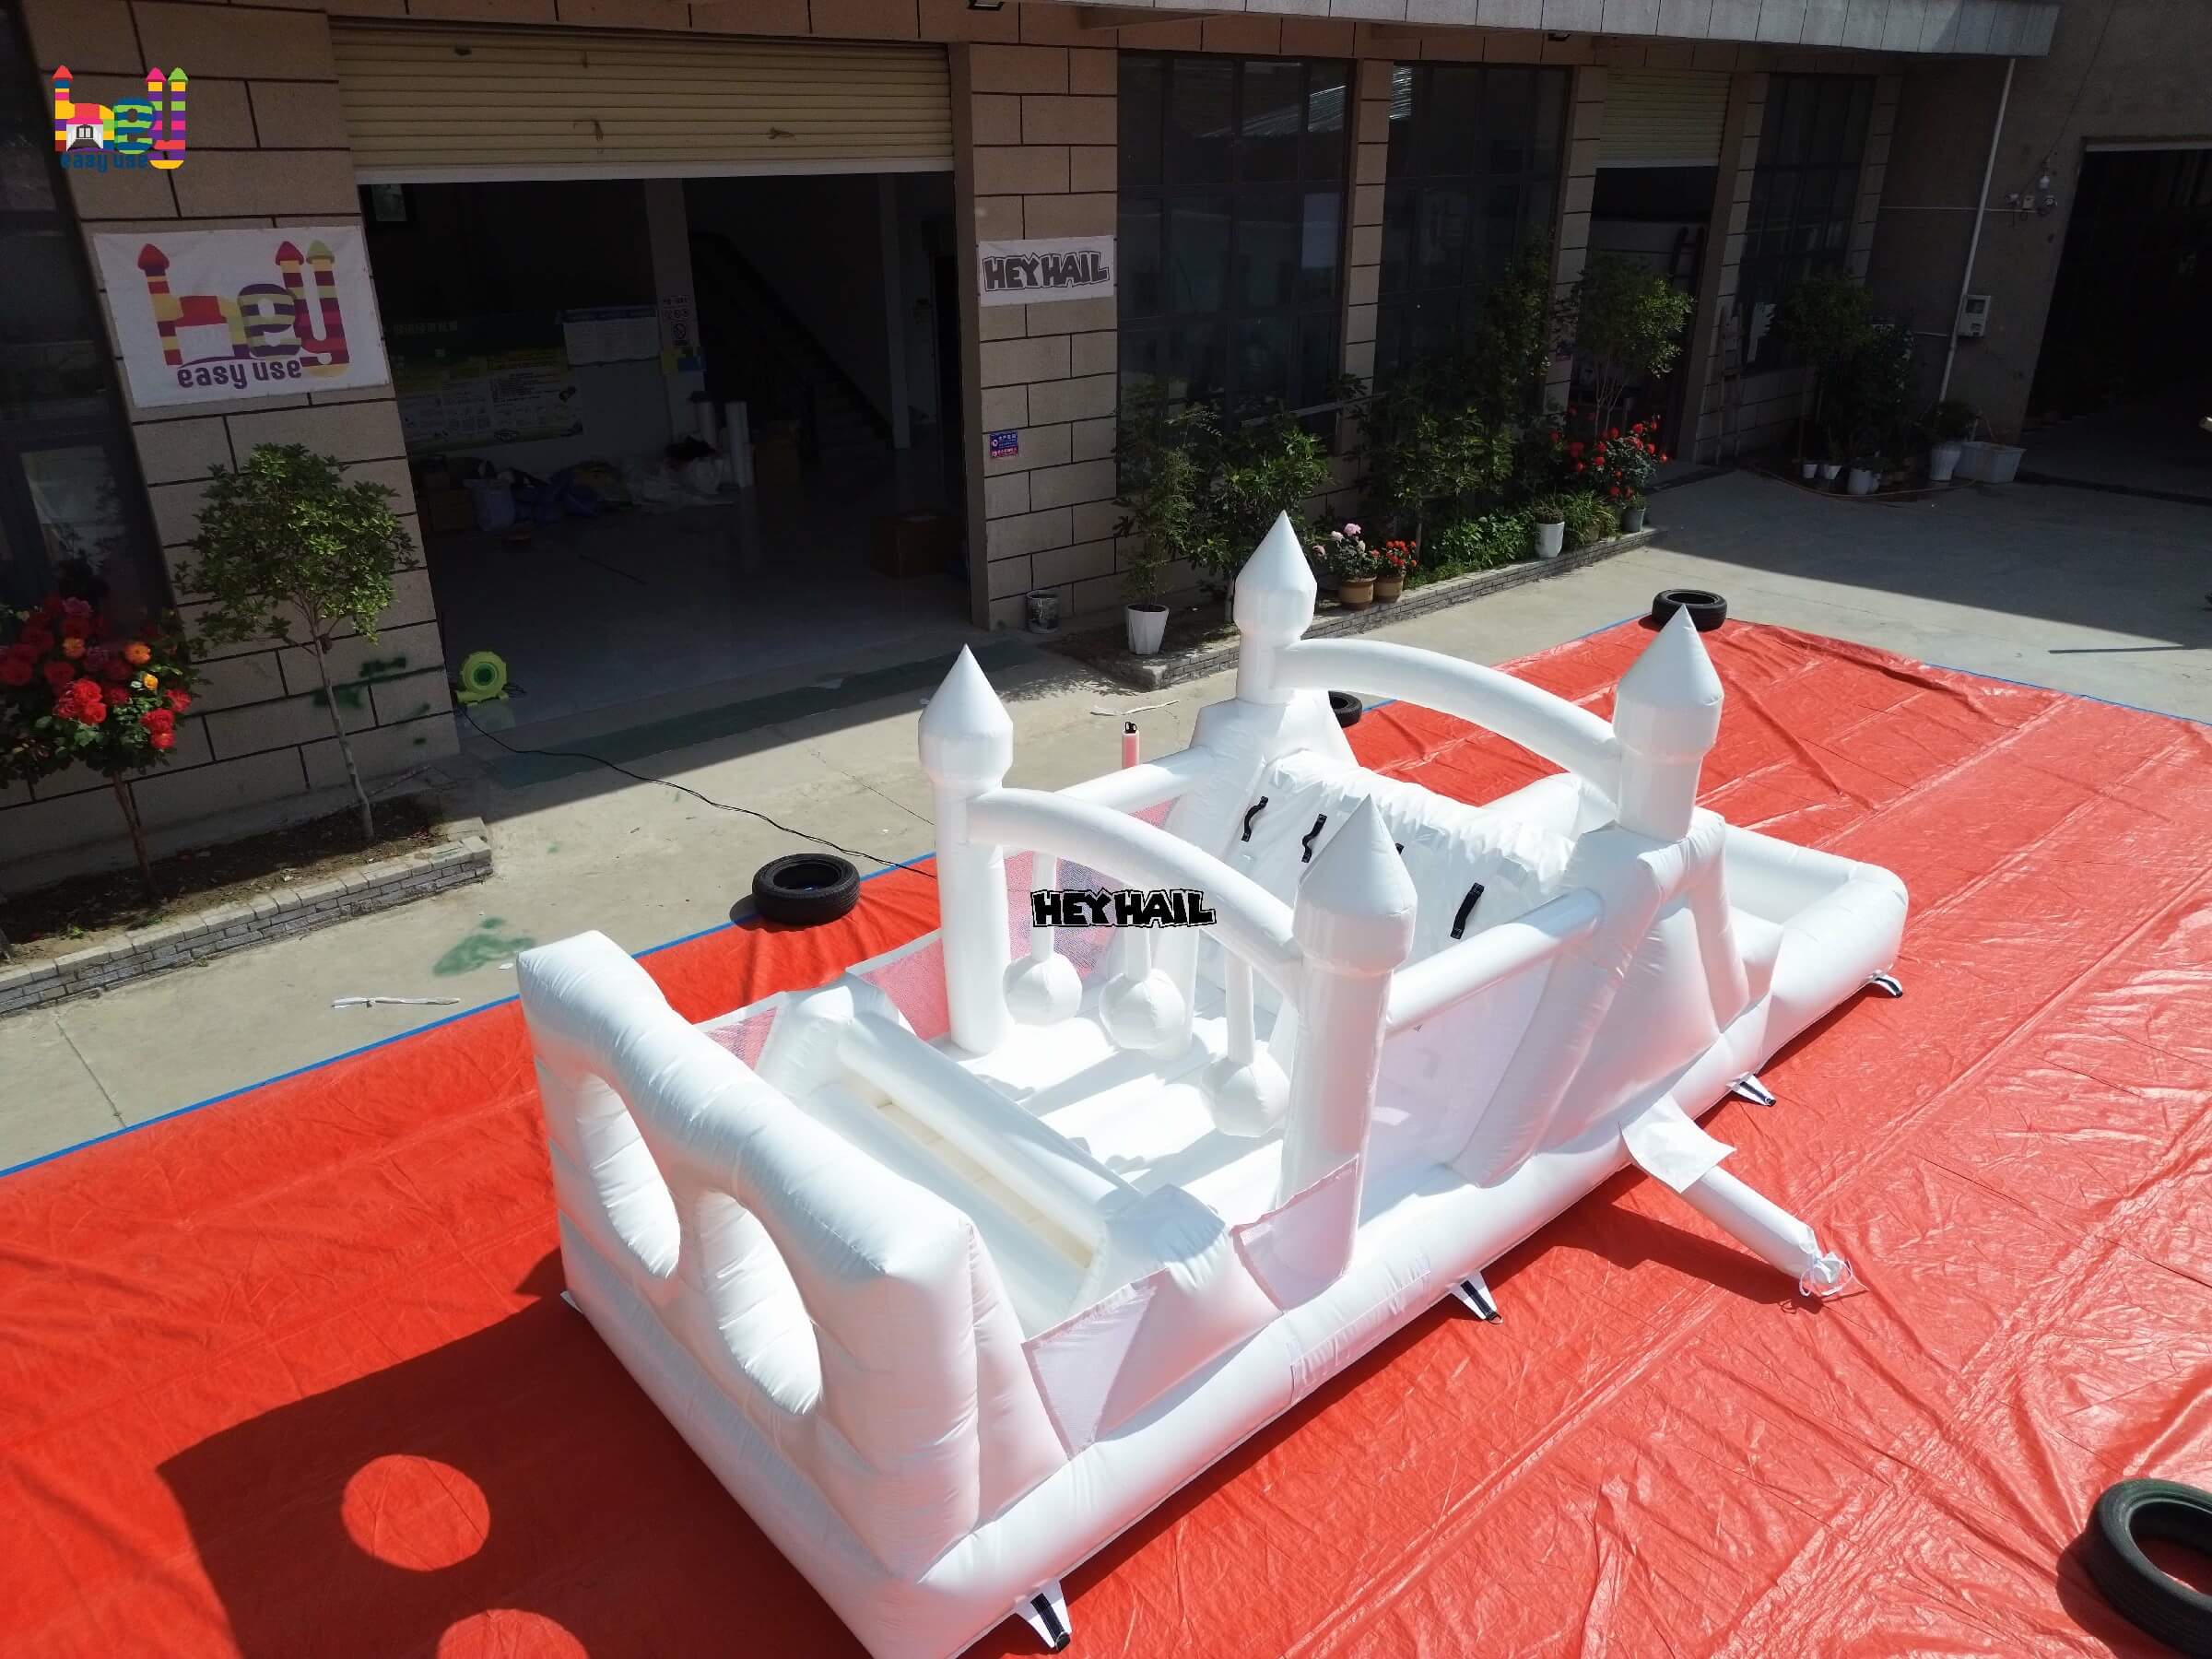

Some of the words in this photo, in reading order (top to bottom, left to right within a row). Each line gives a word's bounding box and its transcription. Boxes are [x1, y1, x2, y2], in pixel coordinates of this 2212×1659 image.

[137, 240, 350, 376] hey
[177, 363, 247, 389] easy
[254, 359, 302, 381] use
